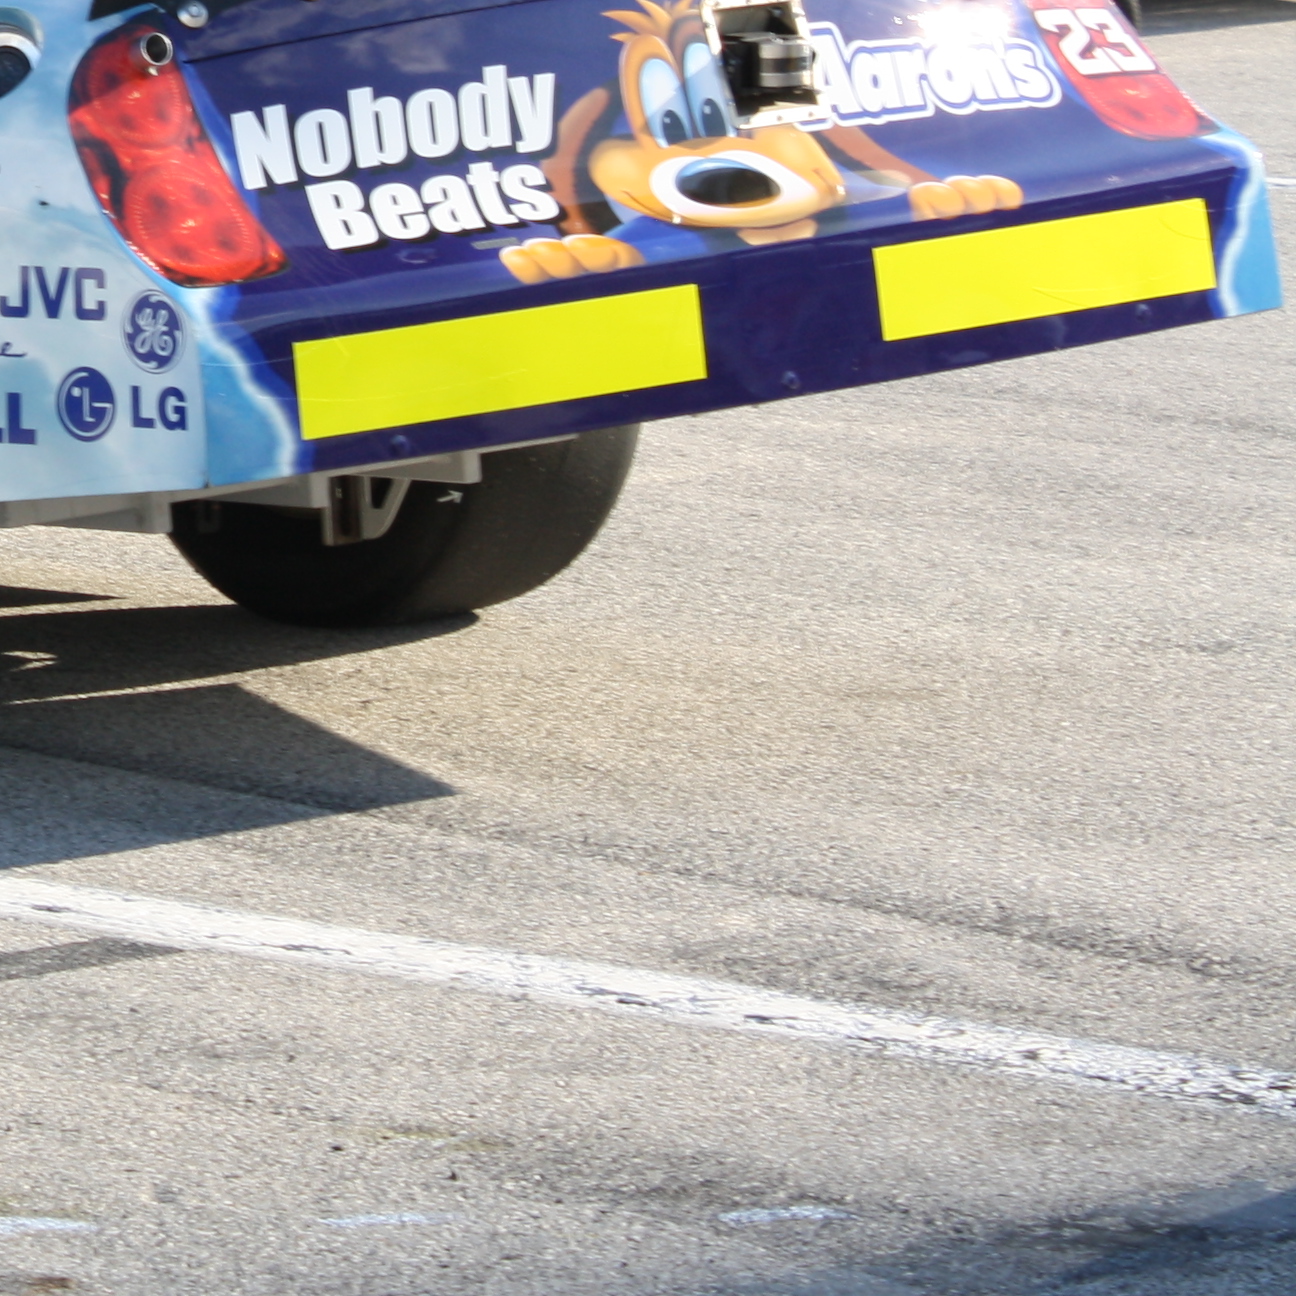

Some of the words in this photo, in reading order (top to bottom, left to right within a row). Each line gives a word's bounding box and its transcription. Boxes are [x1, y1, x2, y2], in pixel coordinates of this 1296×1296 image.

[1033, 6, 1158, 77] 23
[230, 64, 556, 191] Nobody
[304, 161, 561, 250] Beats
[129, 384, 189, 432] LG
